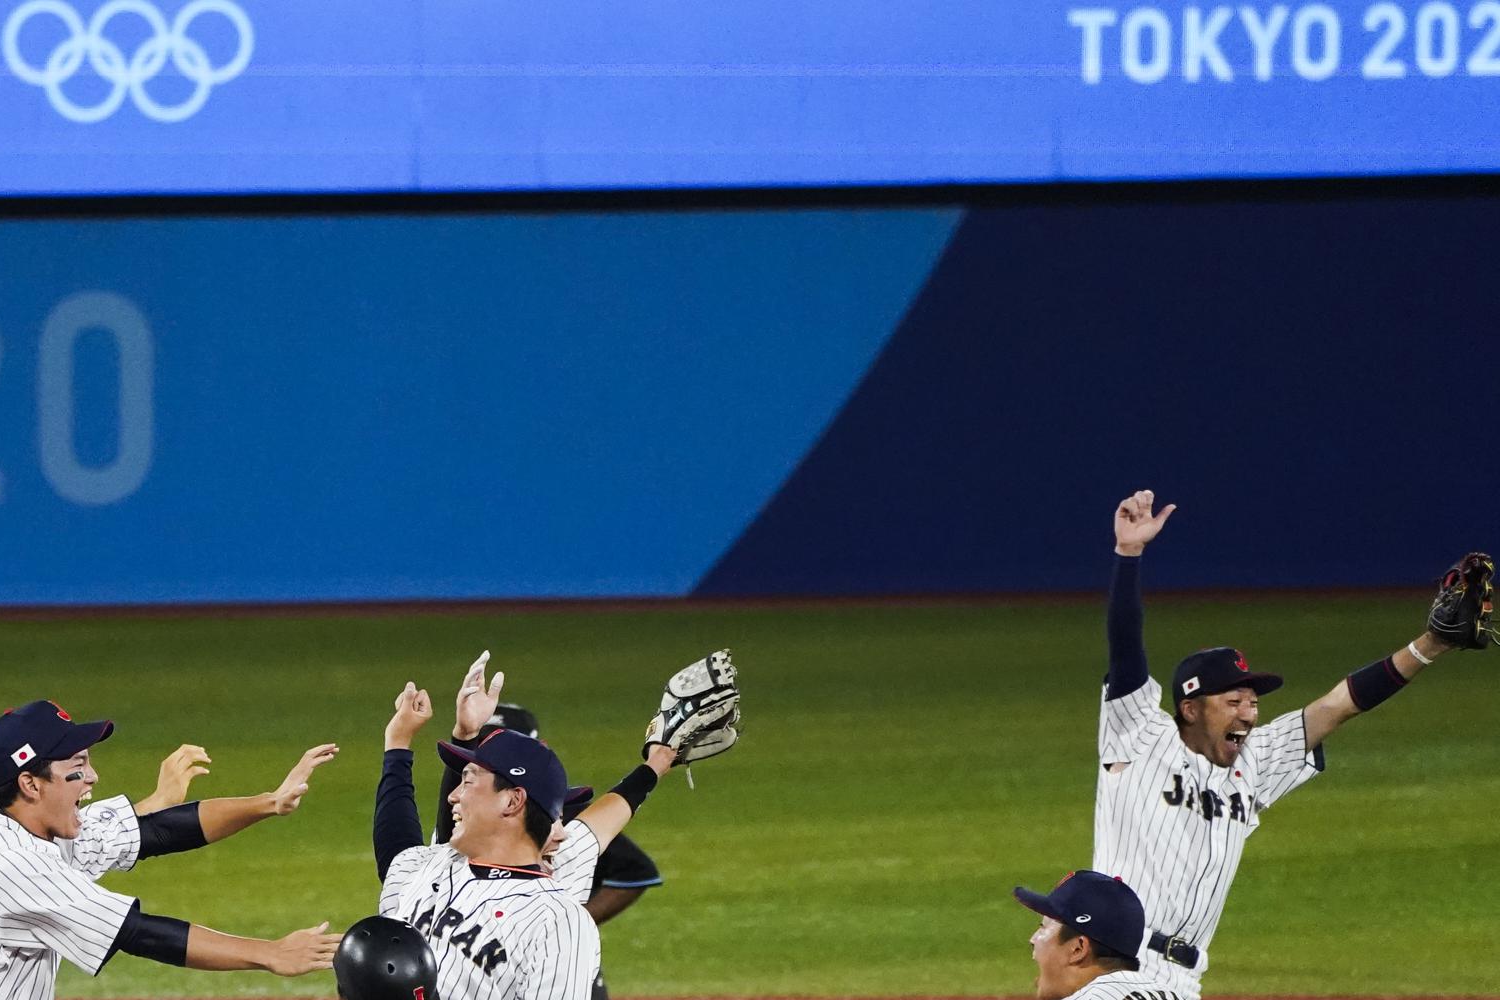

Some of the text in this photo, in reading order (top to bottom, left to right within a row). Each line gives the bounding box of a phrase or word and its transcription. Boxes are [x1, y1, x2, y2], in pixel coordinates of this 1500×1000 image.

[1067, 5, 1341, 84] TOKYO
[1163, 773, 1255, 825] JAPA
[488, 868, 511, 878] 20
